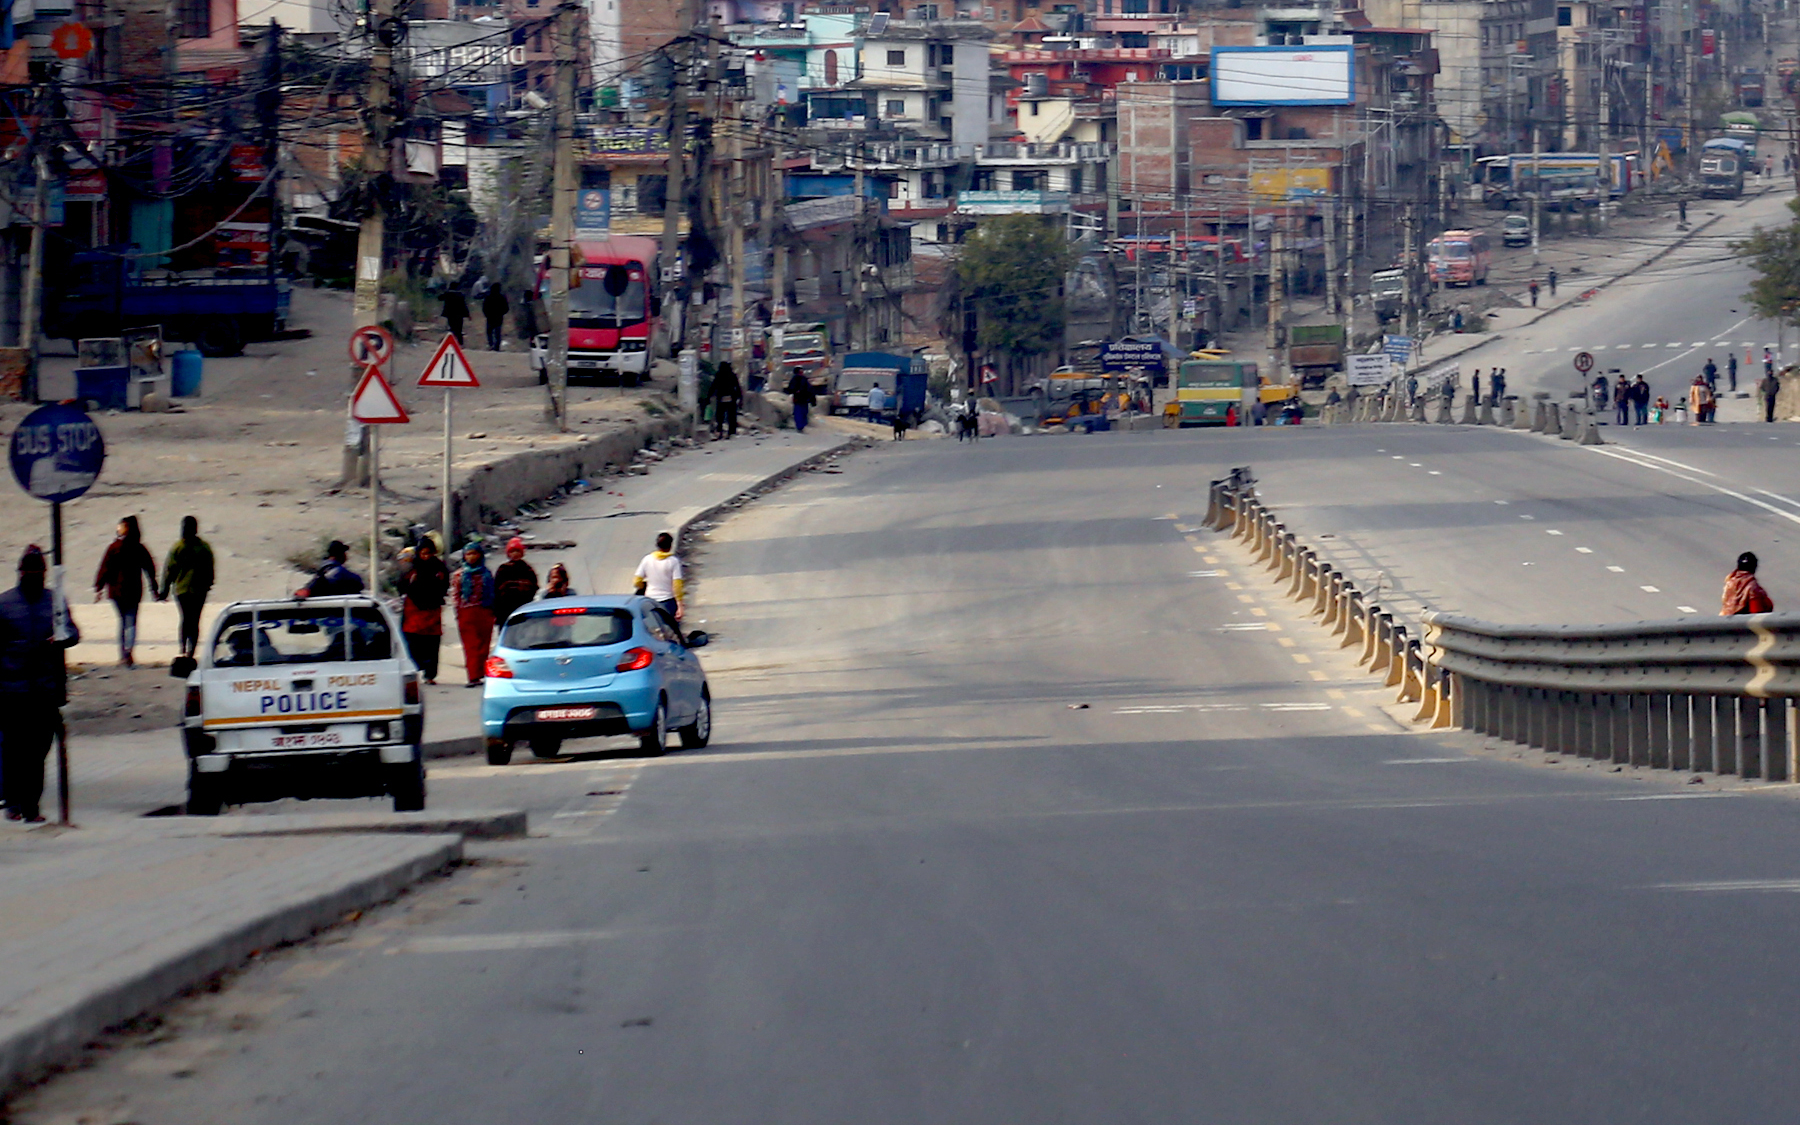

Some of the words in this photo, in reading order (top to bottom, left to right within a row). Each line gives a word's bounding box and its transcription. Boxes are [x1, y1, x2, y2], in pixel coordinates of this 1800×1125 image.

[17, 424, 51, 455] BUS
[57, 422, 98, 452] STOP
[233, 679, 281, 693] NEPAL
[328, 674, 377, 688] POLICE
[261, 691, 349, 713] POLICE
